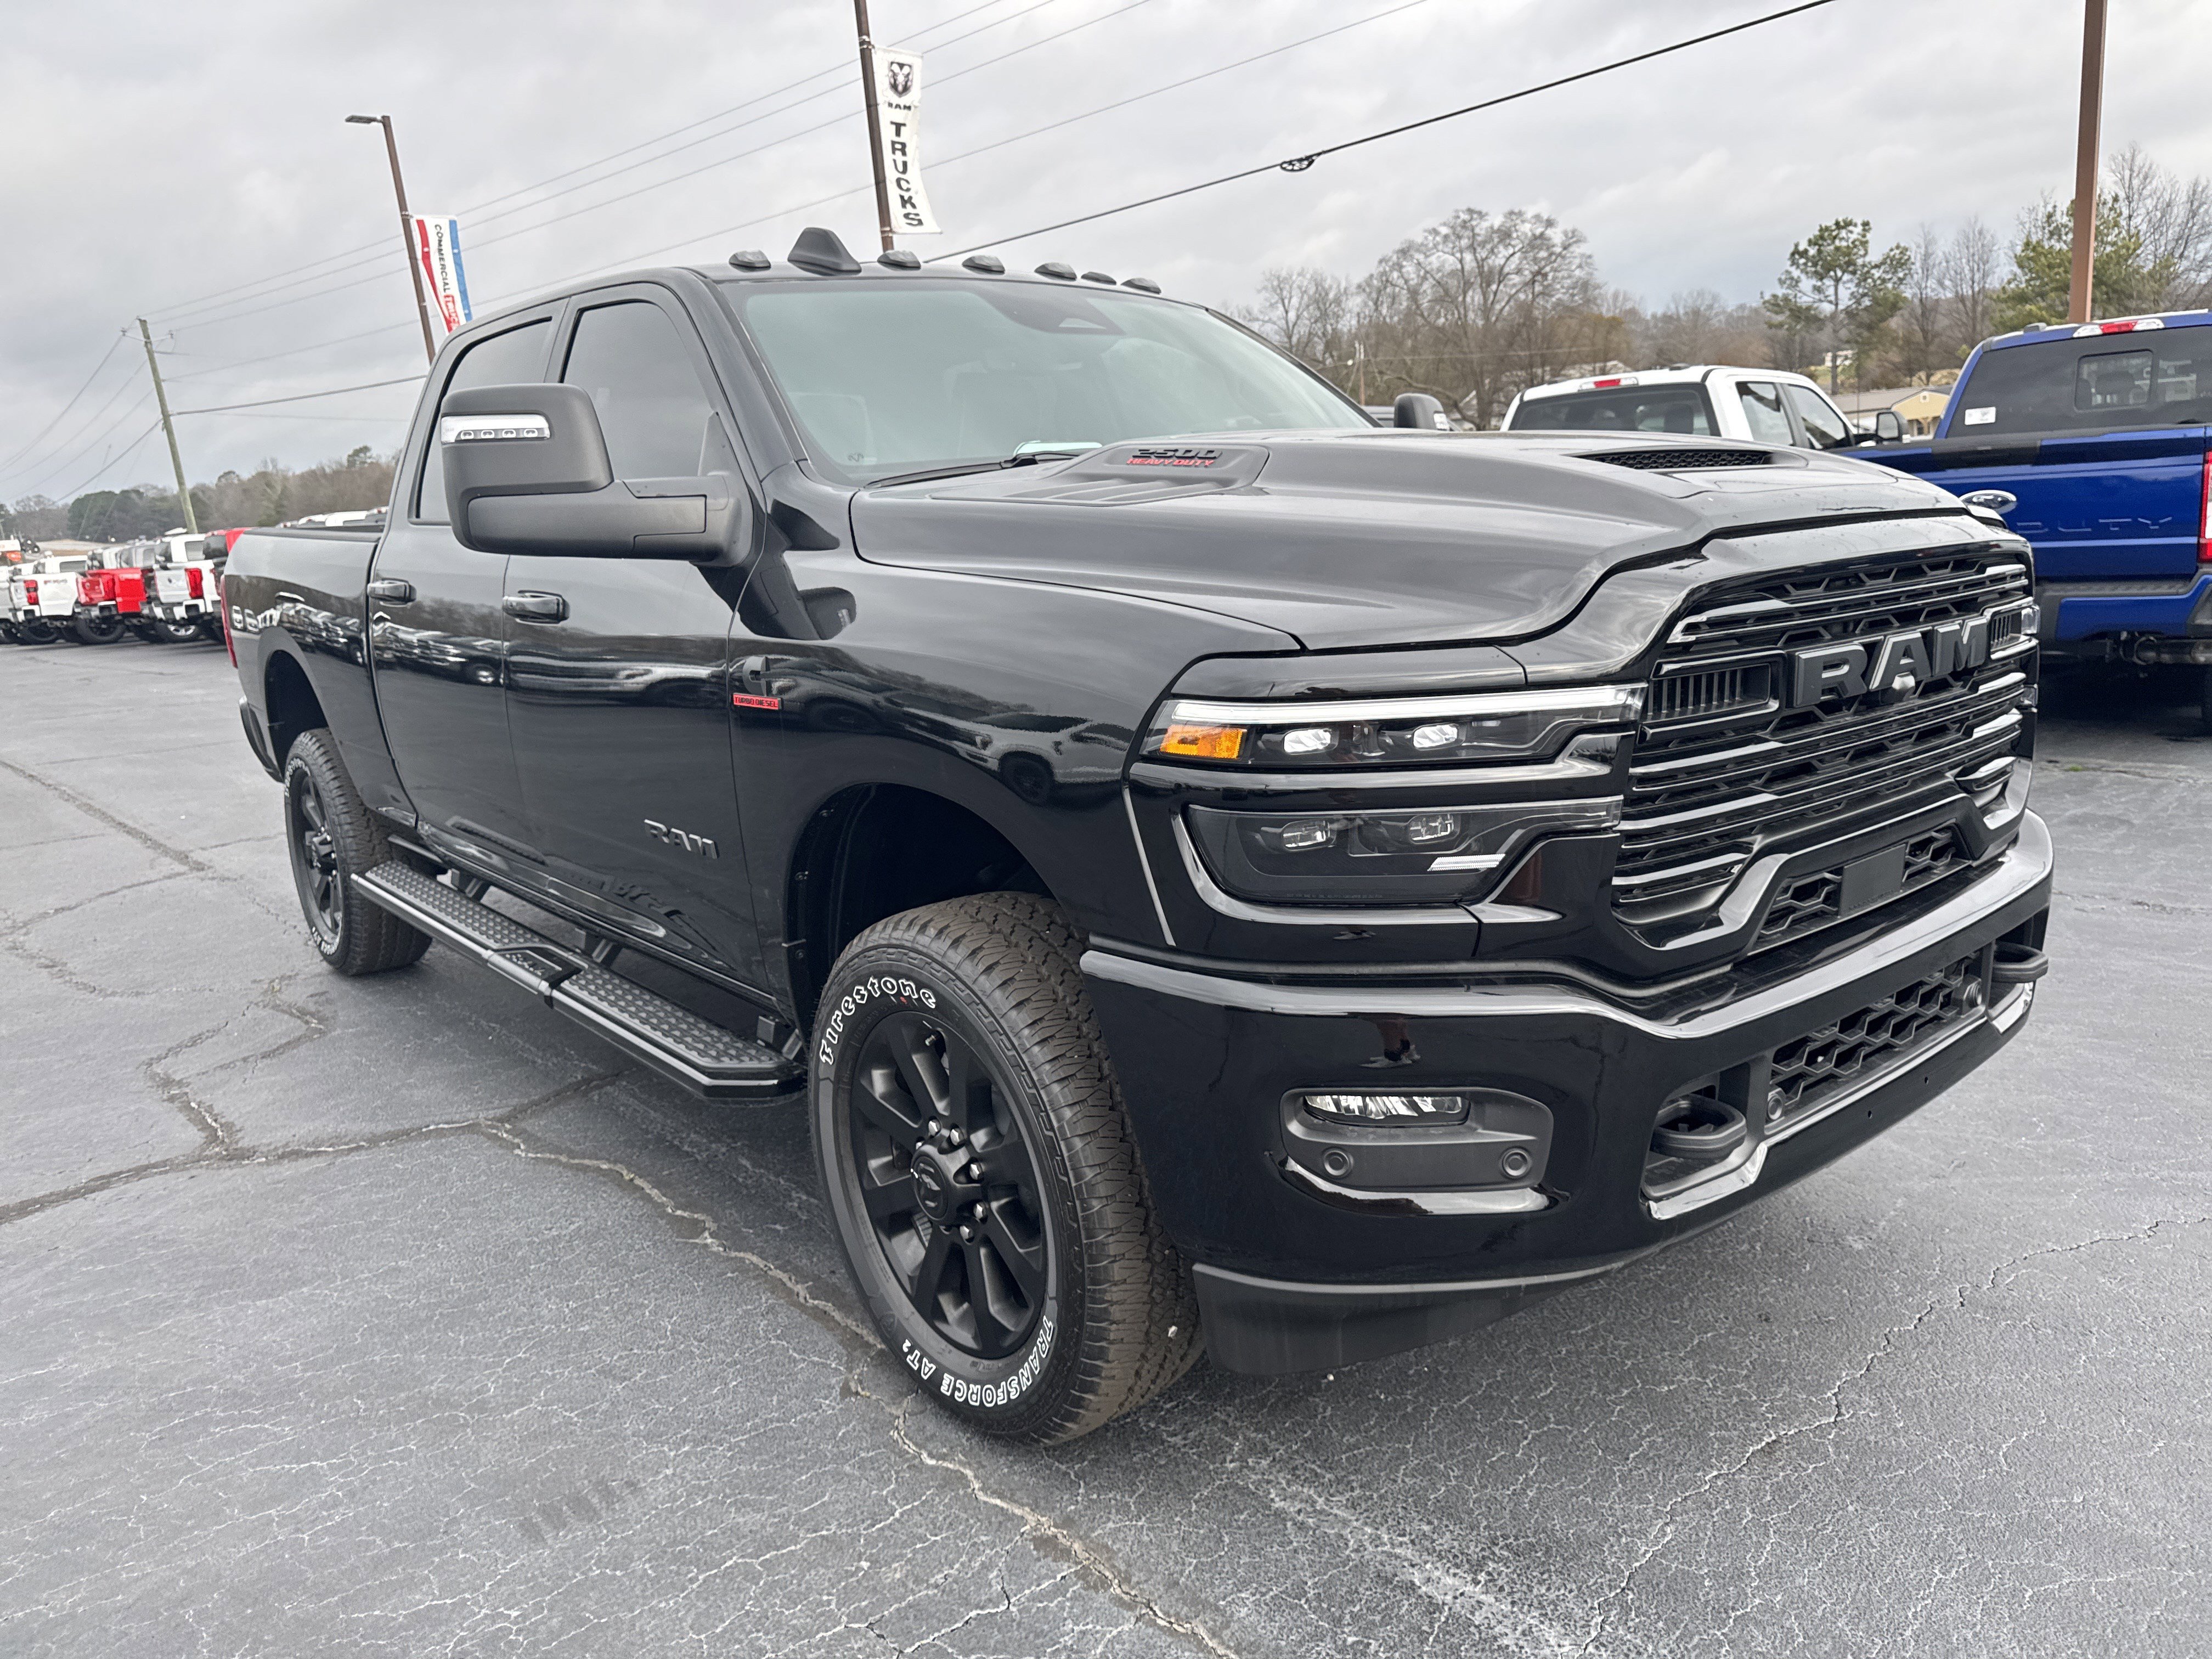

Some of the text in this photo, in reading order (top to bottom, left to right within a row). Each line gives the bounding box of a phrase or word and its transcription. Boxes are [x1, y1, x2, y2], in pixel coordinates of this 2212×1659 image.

[888, 101, 911, 111] RAM
[890, 121, 924, 227] TRUCKS
[435, 224, 450, 293] COMMERCIAL
[1172, 459, 1214, 467] DUTY
[2015, 515, 2172, 533] DUTY
[1793, 616, 1988, 707] RAM
[755, 698, 777, 708] DIESEL
[643, 819, 720, 860] RAM
[940, 1315, 1053, 1407] TRANSFORCE
